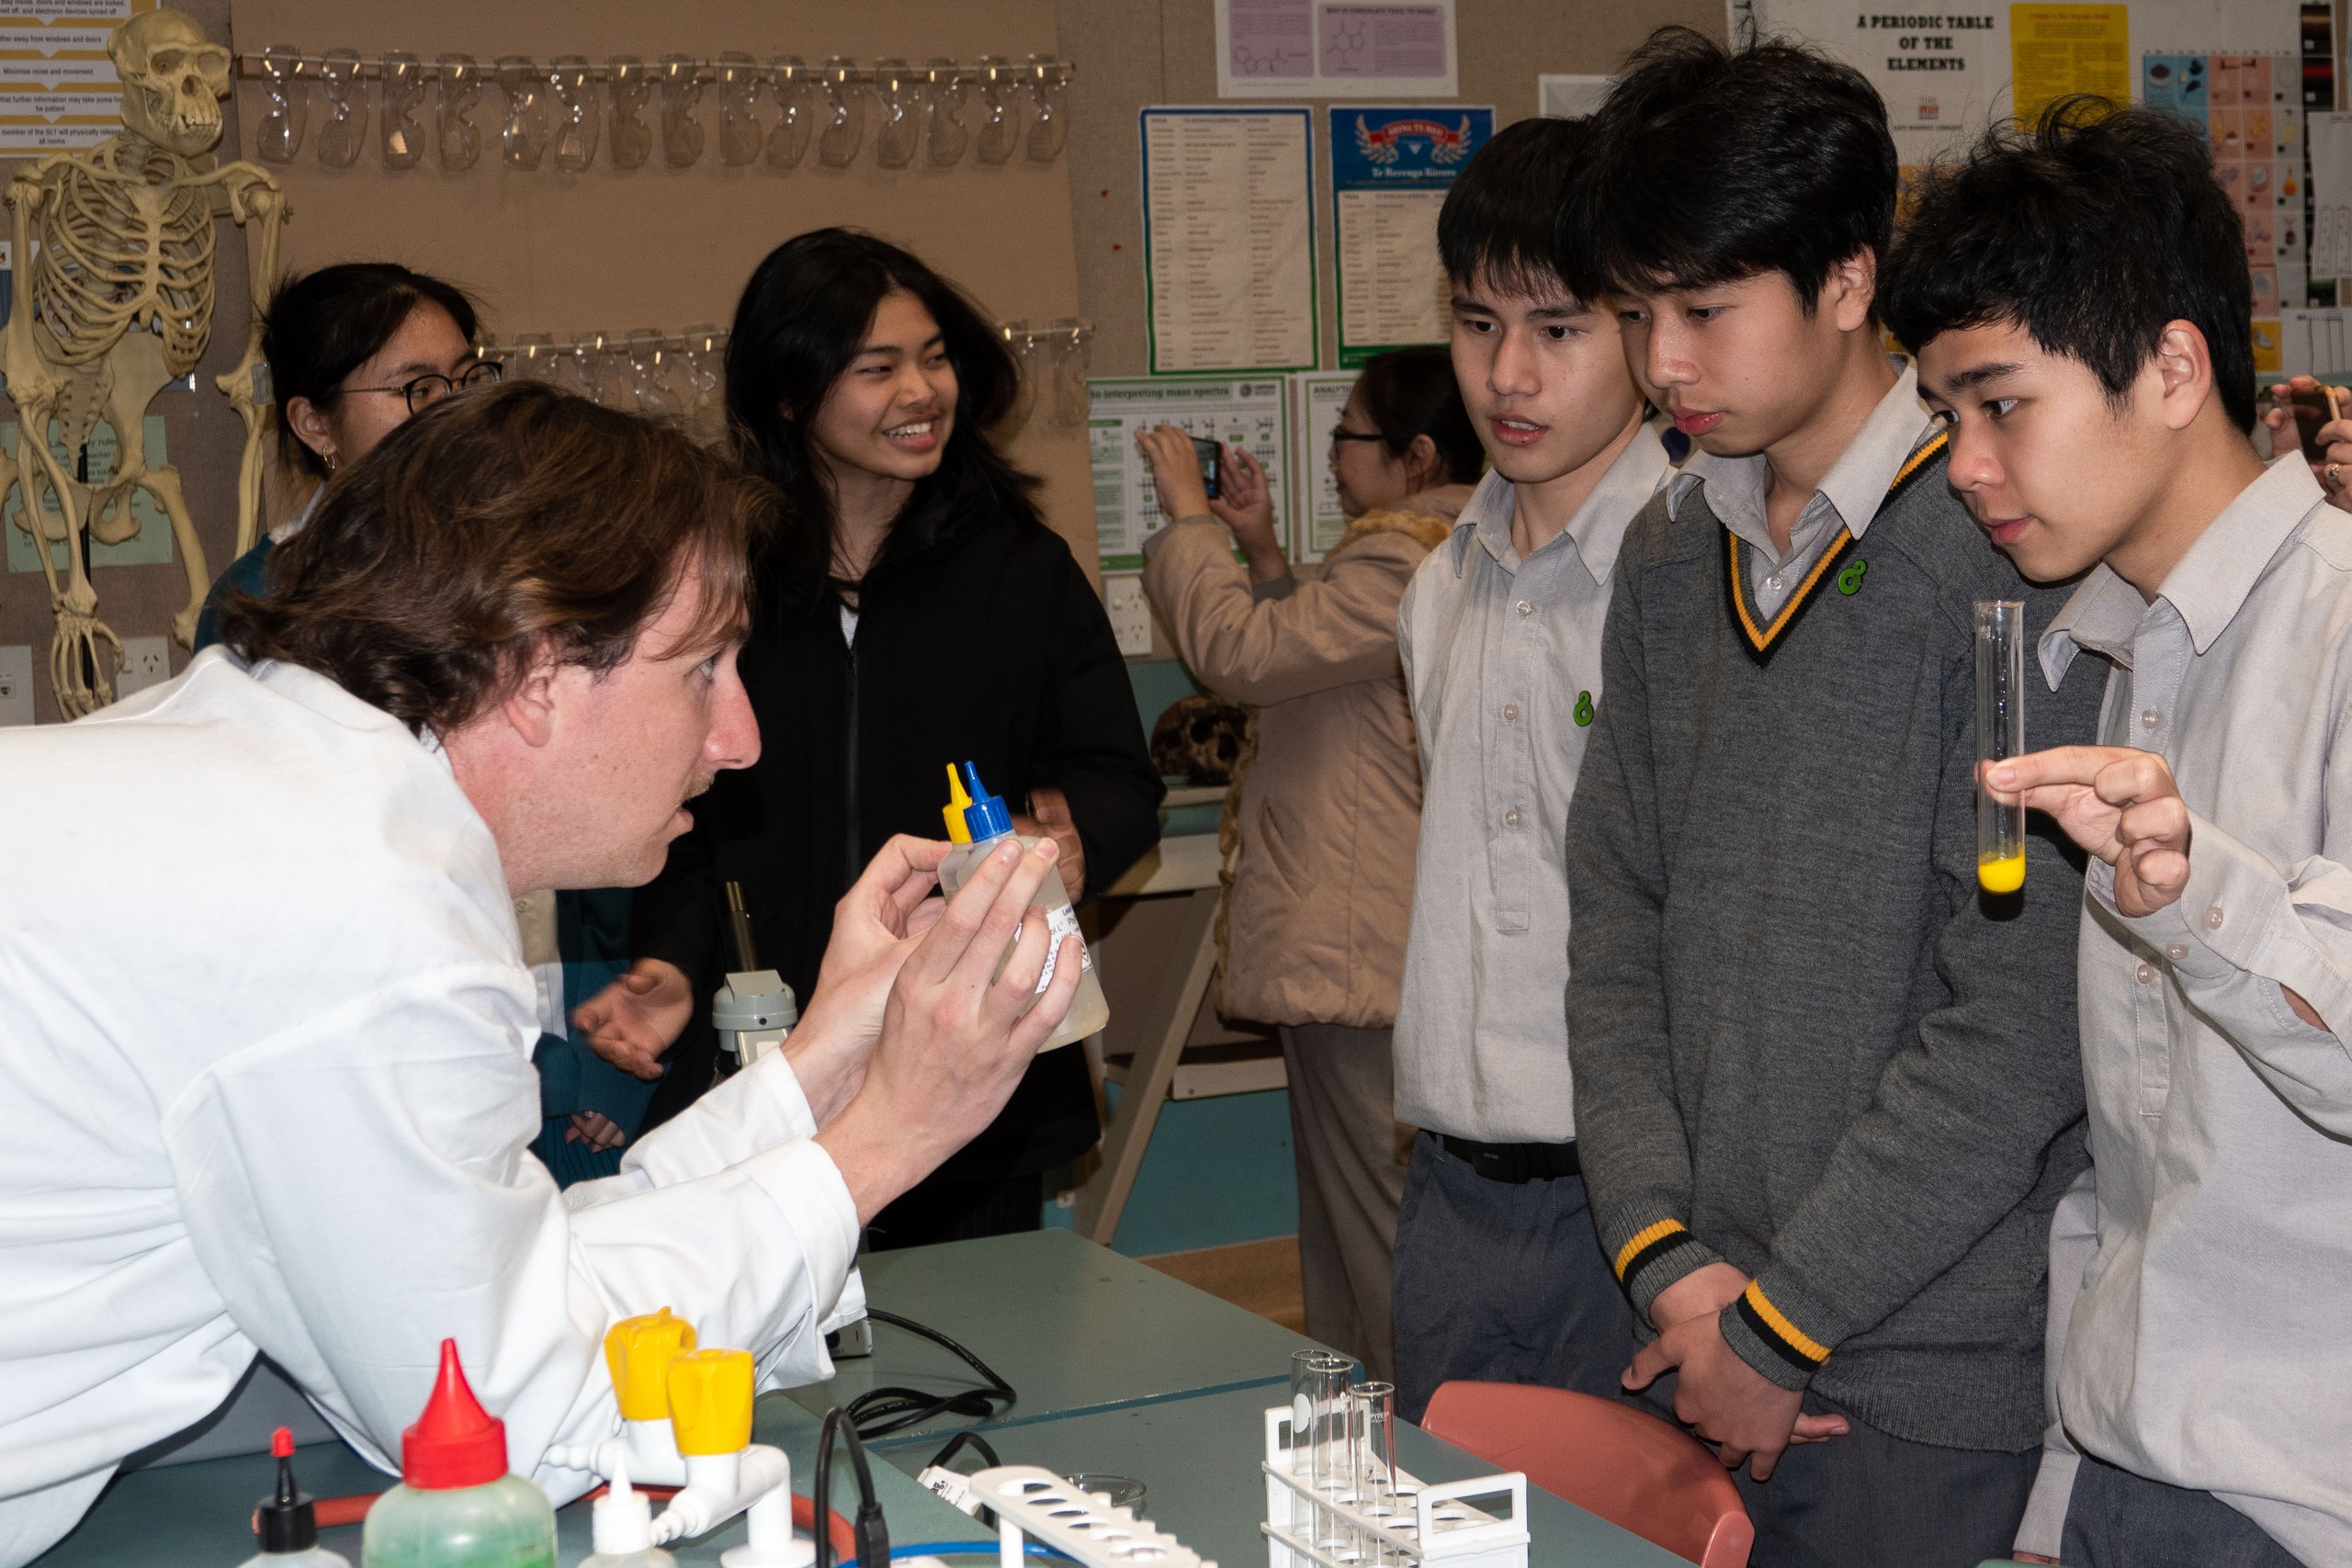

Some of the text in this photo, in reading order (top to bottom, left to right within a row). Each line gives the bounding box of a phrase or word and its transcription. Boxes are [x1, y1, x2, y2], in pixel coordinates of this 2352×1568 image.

[1857, 15, 1995, 28] A PERIODIC TABLE
[1899, 37, 1953, 50] OF THE
[1887, 58, 1965, 71] ELEMENTS
[1104, 388, 1164, 400] interpreting
[1166, 389, 1193, 397] mass
[1194, 388, 1229, 398] spectra
